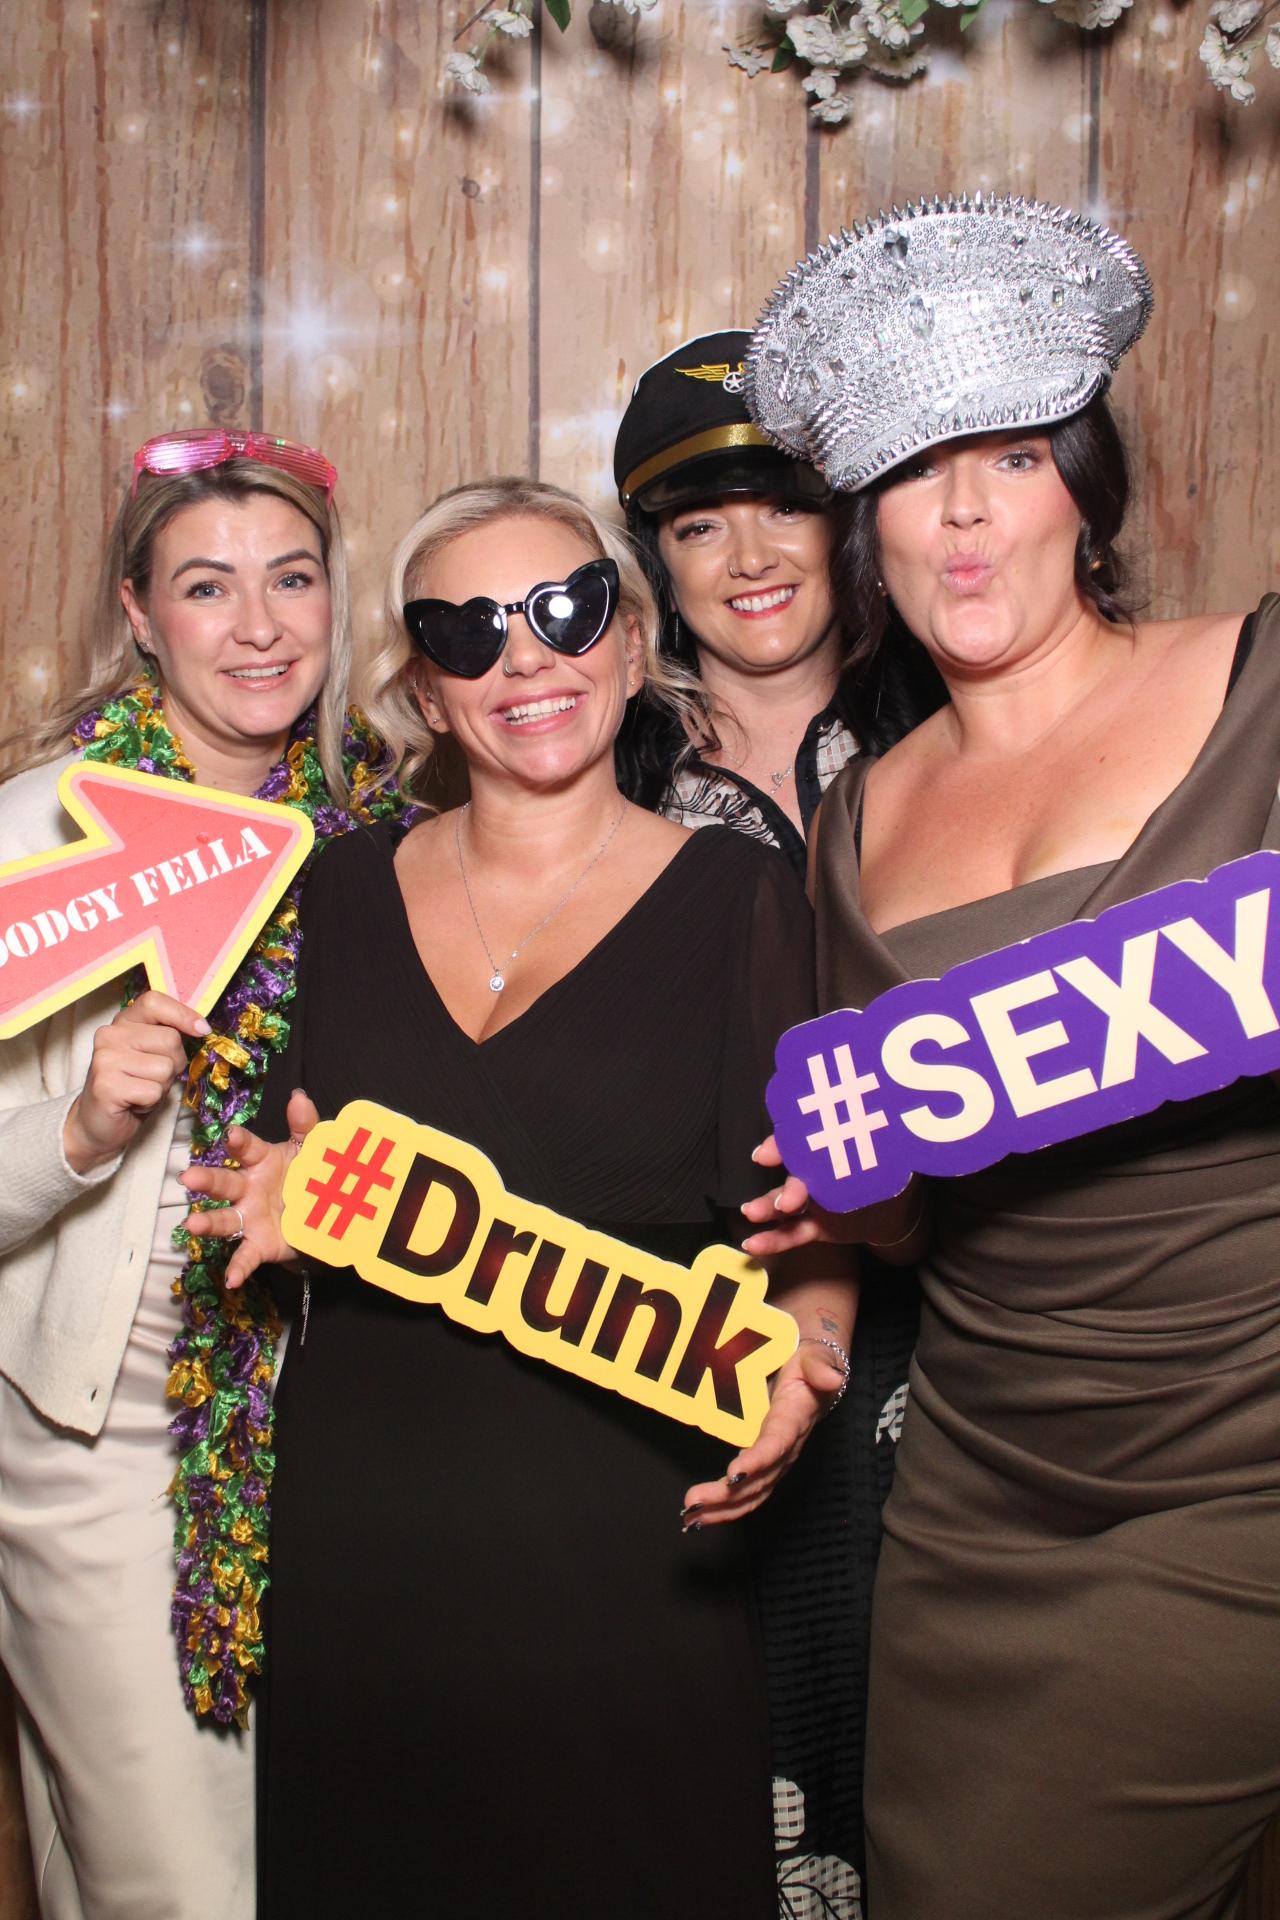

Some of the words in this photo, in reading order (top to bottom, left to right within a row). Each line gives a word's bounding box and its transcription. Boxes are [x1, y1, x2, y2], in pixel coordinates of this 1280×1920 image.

[0, 883, 123, 968] ODGY
[129, 827, 271, 907] FELLA
[797, 888, 1280, 1180] #SEXY
[304, 1126, 772, 1421] #Drunk
